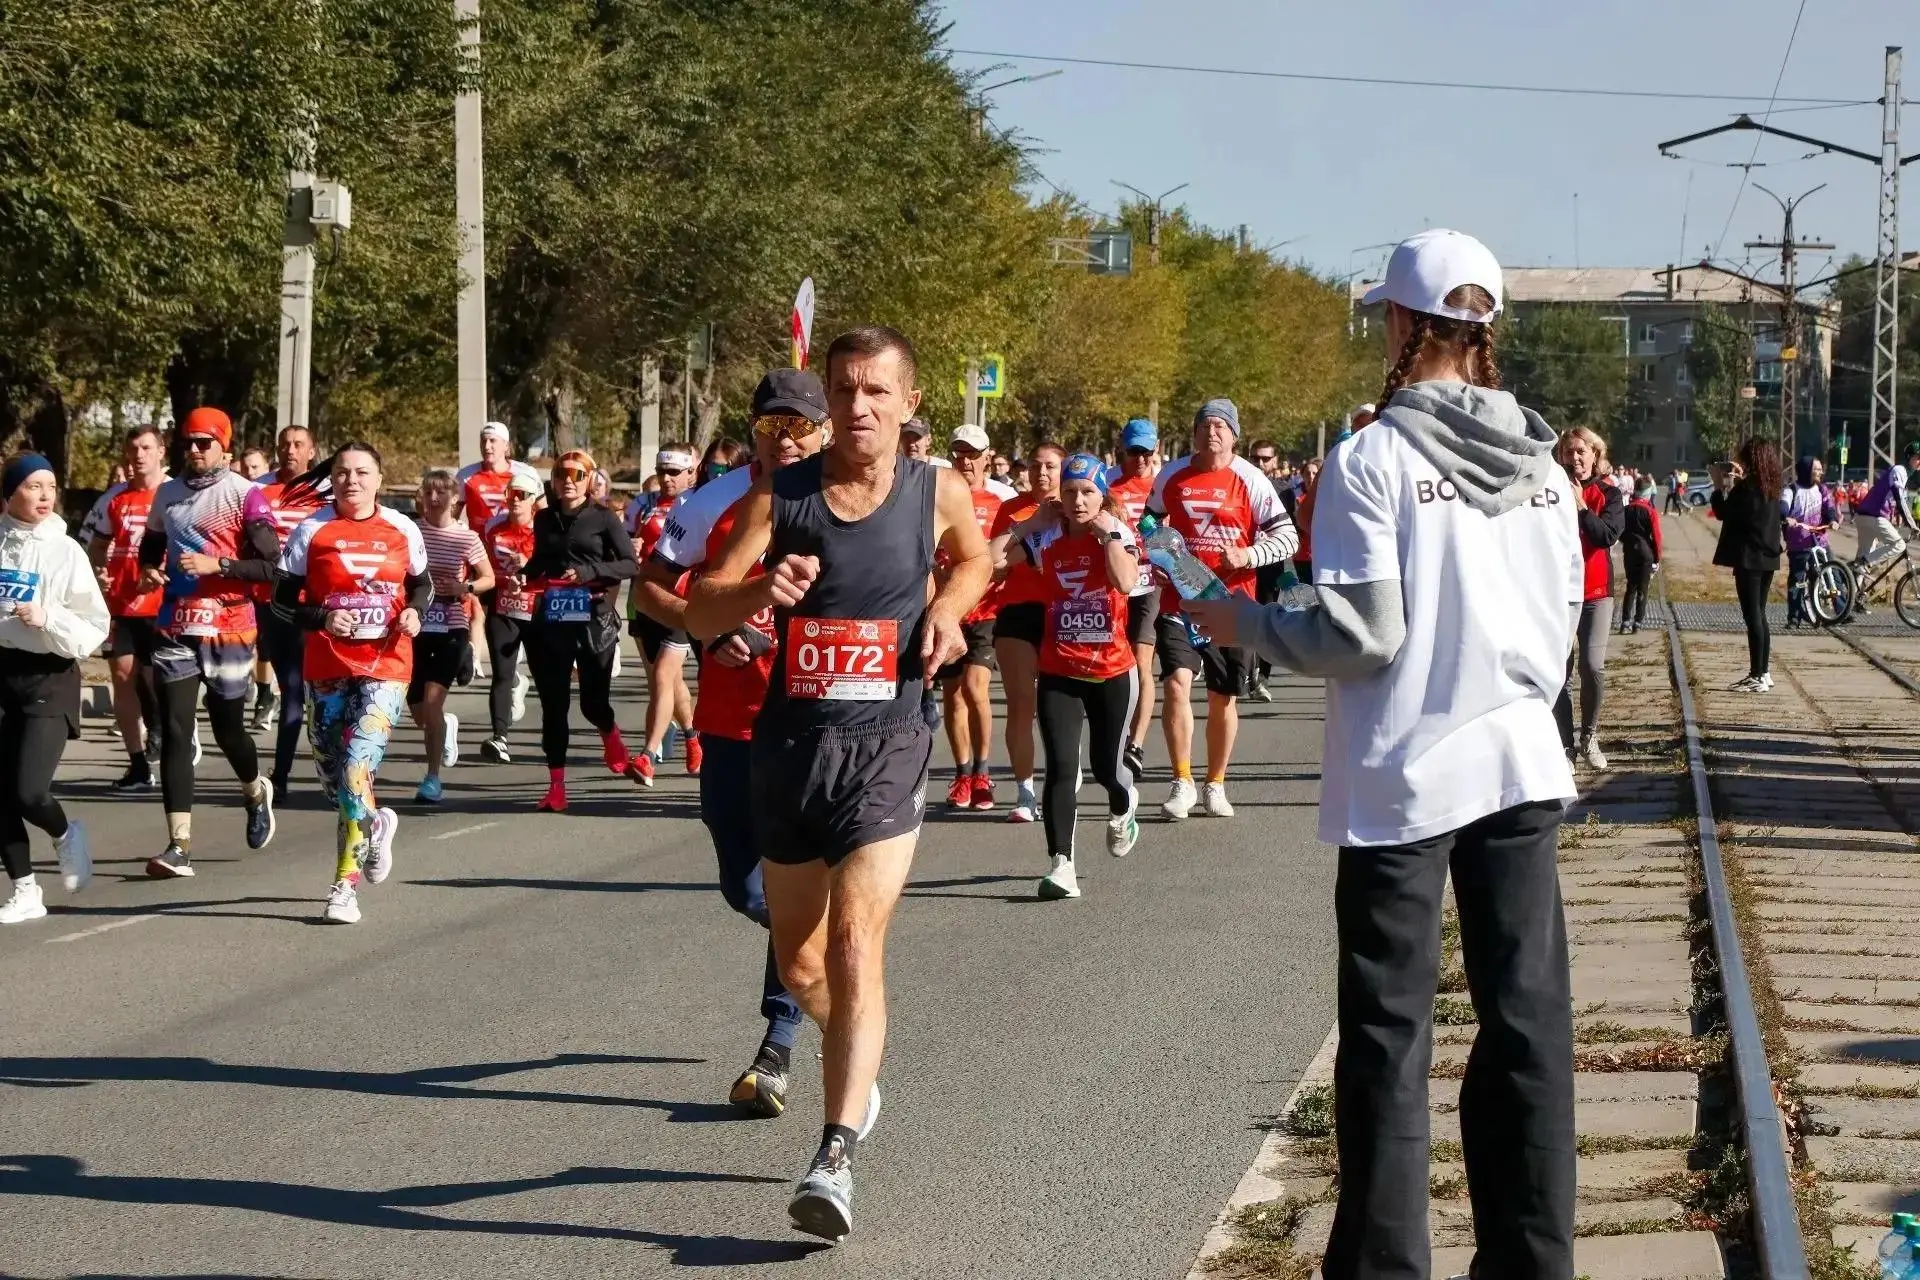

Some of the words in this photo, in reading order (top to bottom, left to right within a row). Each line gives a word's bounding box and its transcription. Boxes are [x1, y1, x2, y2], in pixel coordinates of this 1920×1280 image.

[500, 597, 529, 611] 0205
[551, 598, 584, 611] 0711
[175, 608, 214, 624] 0179
[350, 607, 385, 624] 370
[1061, 613, 1106, 629] 0450
[799, 643, 884, 673] 0172
[791, 682, 801, 693] 21
